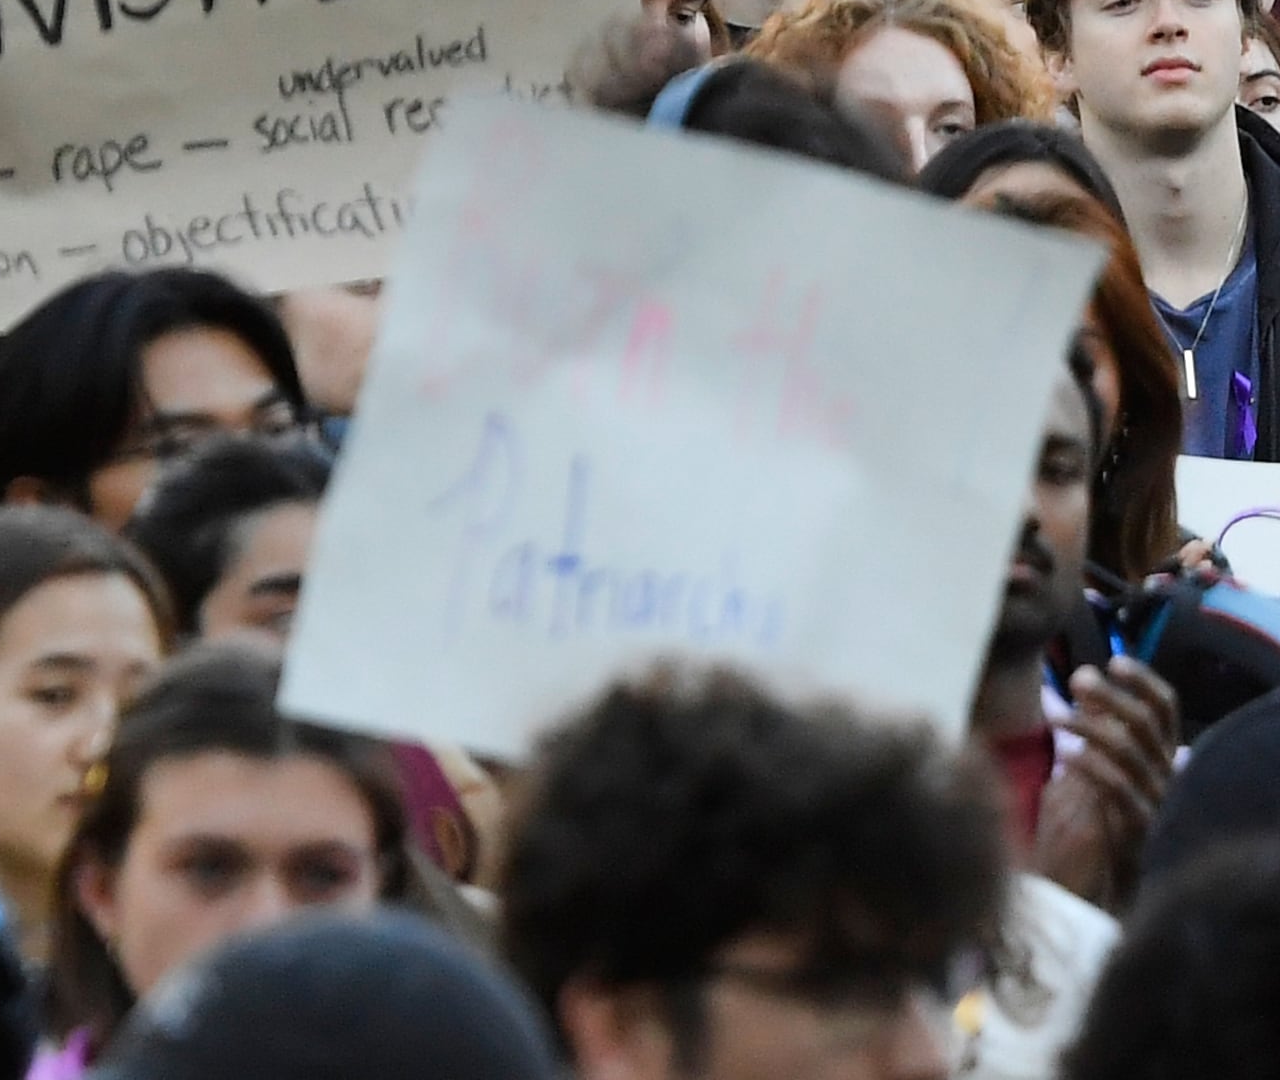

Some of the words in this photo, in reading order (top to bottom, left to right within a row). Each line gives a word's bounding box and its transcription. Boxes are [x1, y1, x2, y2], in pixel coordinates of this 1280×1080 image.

[278, 23, 487, 97] undervalued
[52, 131, 163, 191] rape
[254, 85, 354, 151] social
